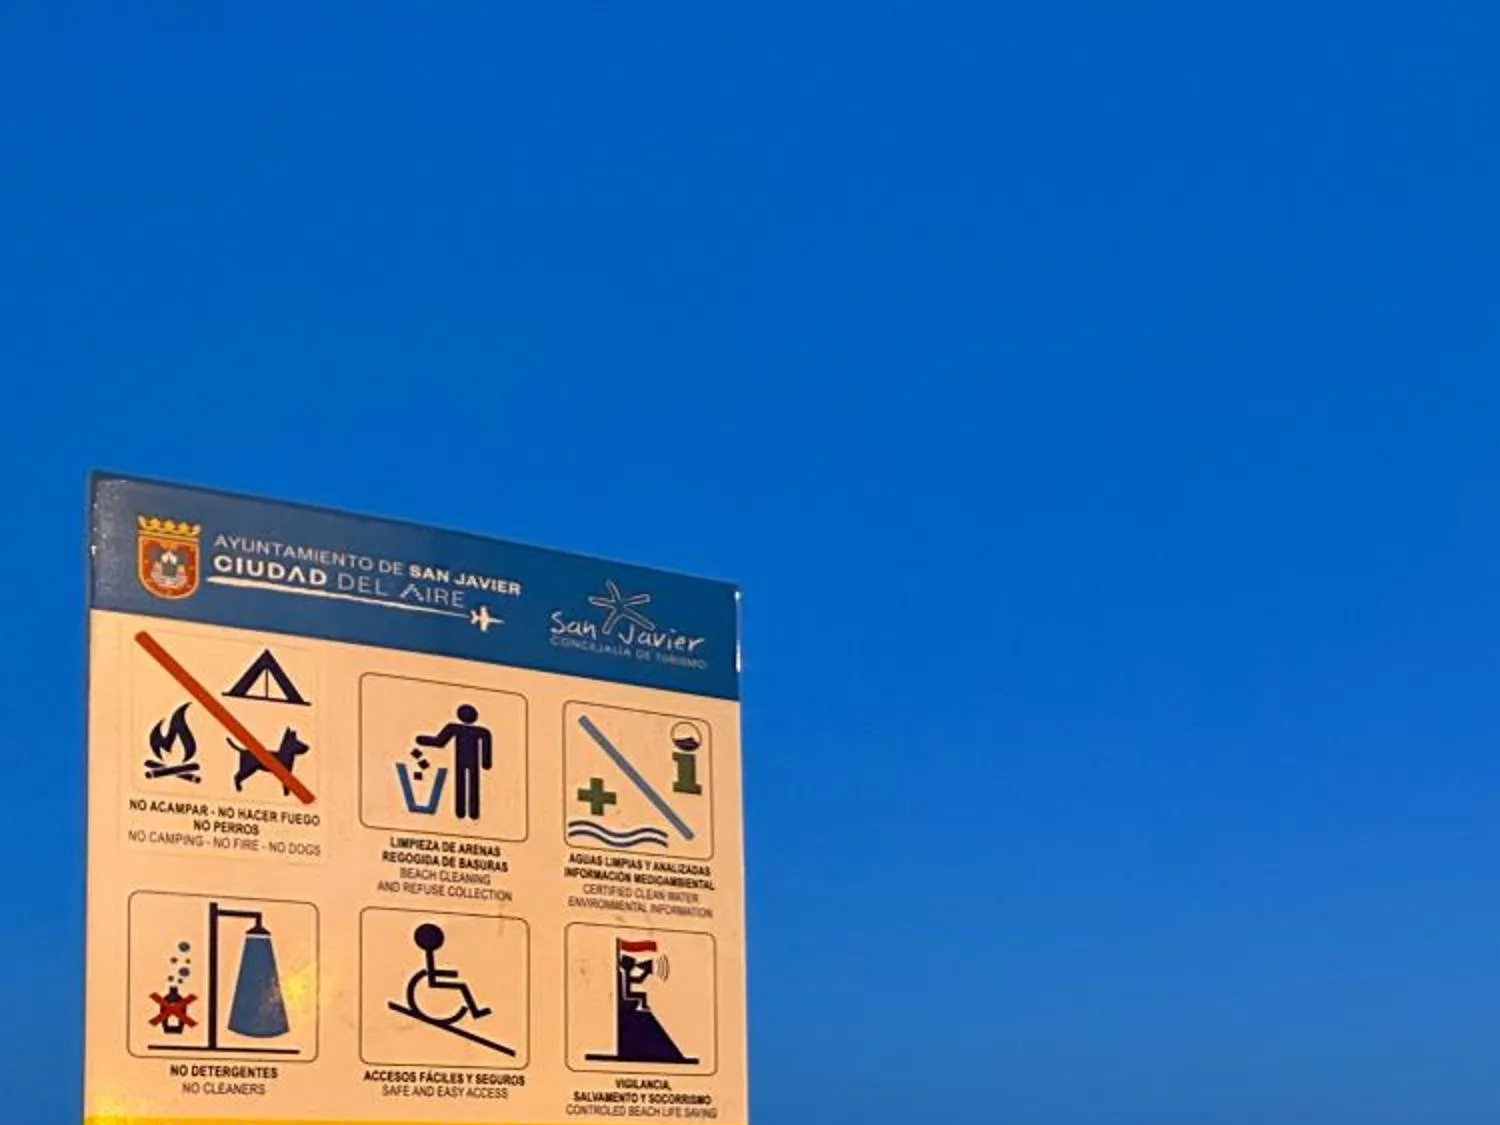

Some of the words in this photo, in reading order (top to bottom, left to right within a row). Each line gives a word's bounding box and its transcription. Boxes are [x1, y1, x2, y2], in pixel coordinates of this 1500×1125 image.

[214, 535, 373, 571] AYUNTAMIENTO
[379, 559, 403, 575] DE
[409, 564, 448, 582] SAN
[455, 573, 521, 596] JAVIER
[213, 555, 327, 585] CIUDAD
[338, 573, 389, 596] DEL
[401, 584, 465, 608] AIRE
[551, 611, 597, 640] San
[618, 624, 704, 652] Javier
[636, 650, 649, 661] DE
[129, 799, 146, 810] NO
[150, 800, 208, 816] ACAMPAR
[218, 806, 234, 819] NO
[238, 808, 278, 822] HACER
[281, 811, 320, 826] FUEGO
[194, 819, 210, 831] NO
[214, 821, 260, 836] PERROS
[128, 830, 146, 842] NO
[150, 831, 204, 848] CAMPING
[213, 837, 230, 849] NO
[234, 838, 260, 851] FIRE
[269, 841, 285, 854] NO
[288, 843, 320, 856] DOGS
[390, 836, 439, 851] LIMPIEZA
[442, 842, 457, 852] DE
[459, 844, 501, 857] ARENAS
[442, 856, 457, 867] DE
[459, 858, 508, 872] BASURAS
[569, 853, 602, 865] AGUAS
[605, 856, 643, 870] LIMPIAS
[645, 860, 651, 870] Y
[653, 862, 711, 876] ANALIZADAS
[400, 867, 437, 880] BEACH
[439, 870, 491, 885] CLEANING
[378, 880, 401, 892] AND
[403, 882, 445, 897] REFUSE
[448, 886, 512, 901] COLLECTION
[583, 883, 632, 897] CERTIFIED
[634, 888, 664, 900] CLEAN
[170, 1064, 188, 1077] NO
[191, 1065, 278, 1078] DETERGENTES
[363, 1070, 416, 1083] ACCESOS
[466, 1073, 474, 1084] Y
[475, 1074, 525, 1086] SEGUROS
[182, 1082, 200, 1094] NO
[203, 1083, 266, 1095] CLEANERS
[382, 1084, 410, 1097] SAFE
[410, 1085, 434, 1097] AND
[437, 1086, 467, 1098] EASY
[467, 1087, 508, 1099] ACCESS
[573, 1091, 638, 1103] SALVAMENTO
[640, 1093, 647, 1103] Y
[628, 1106, 660, 1117] BEACH
[662, 1107, 682, 1117] LIFE
[684, 1108, 717, 1118] SAVING
